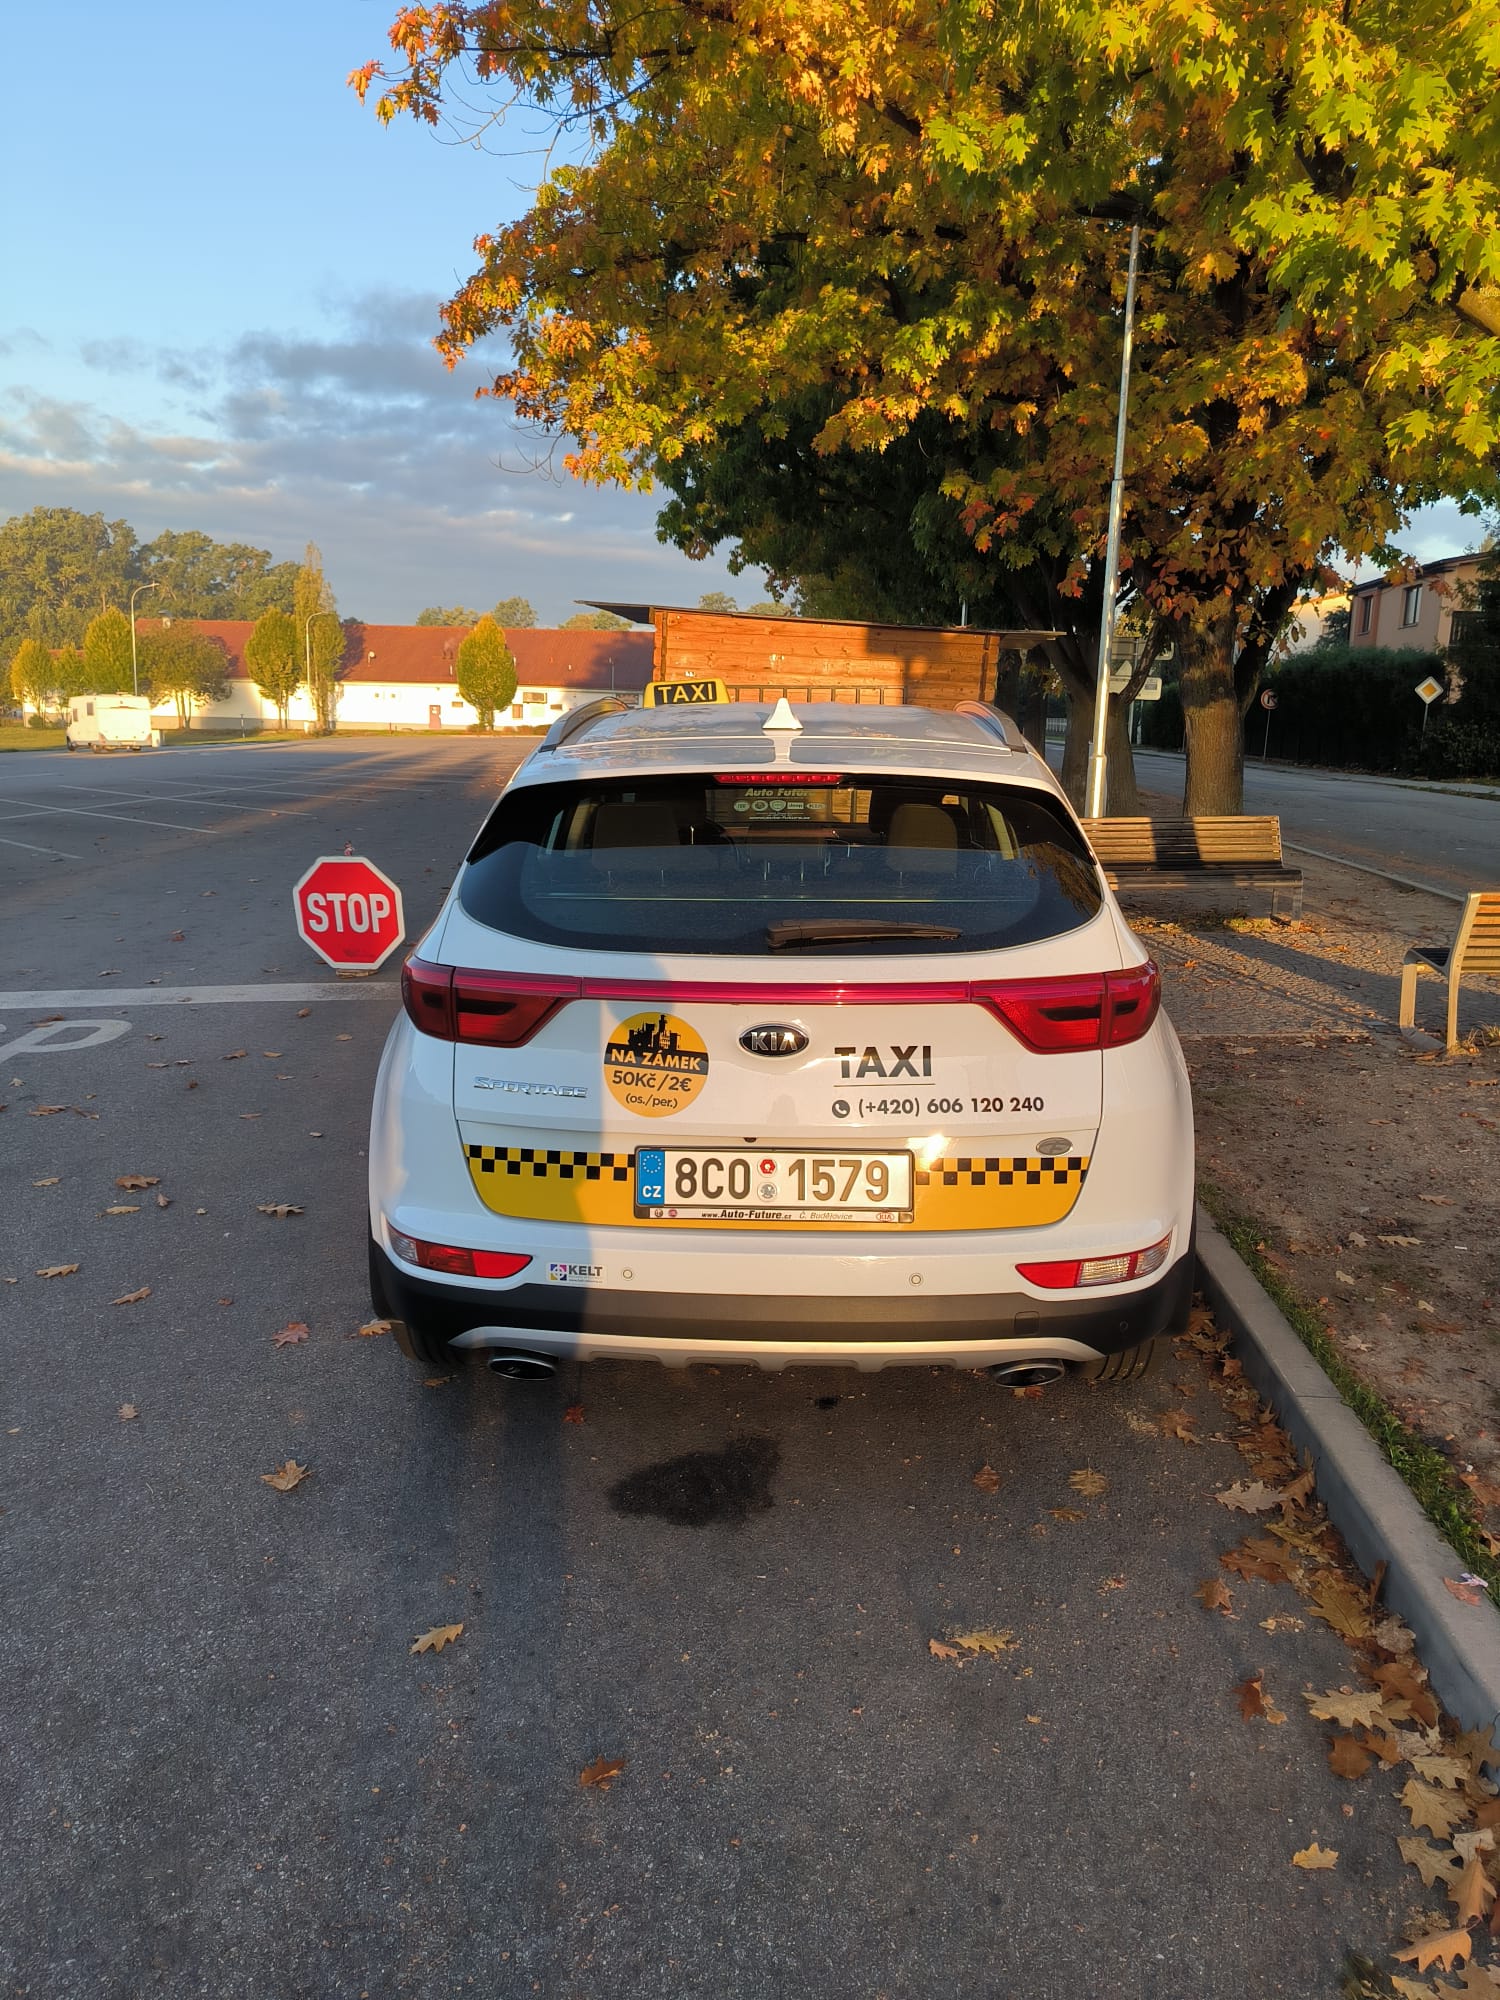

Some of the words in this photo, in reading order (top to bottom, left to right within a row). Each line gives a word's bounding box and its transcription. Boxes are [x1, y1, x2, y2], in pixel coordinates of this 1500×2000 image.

[657, 683, 713, 704] TAXI
[745, 788, 774, 797] Auto
[307, 892, 390, 933] STOP
[750, 1031, 799, 1051] KIA
[611, 1048, 637, 1064] NA
[641, 1050, 701, 1071] ZÁMEK
[834, 1045, 933, 1080] TAXI
[473, 1076, 589, 1099] SPORTAGE
[858, 1098, 920, 1119] (+420)
[926, 1098, 964, 1115] 606
[971, 1097, 1004, 1114] 120
[1009, 1096, 1045, 1113] 240
[642, 1185, 662, 1198] CZ
[788, 1158, 890, 1202] 1579
[568, 1264, 603, 1277] KELT
